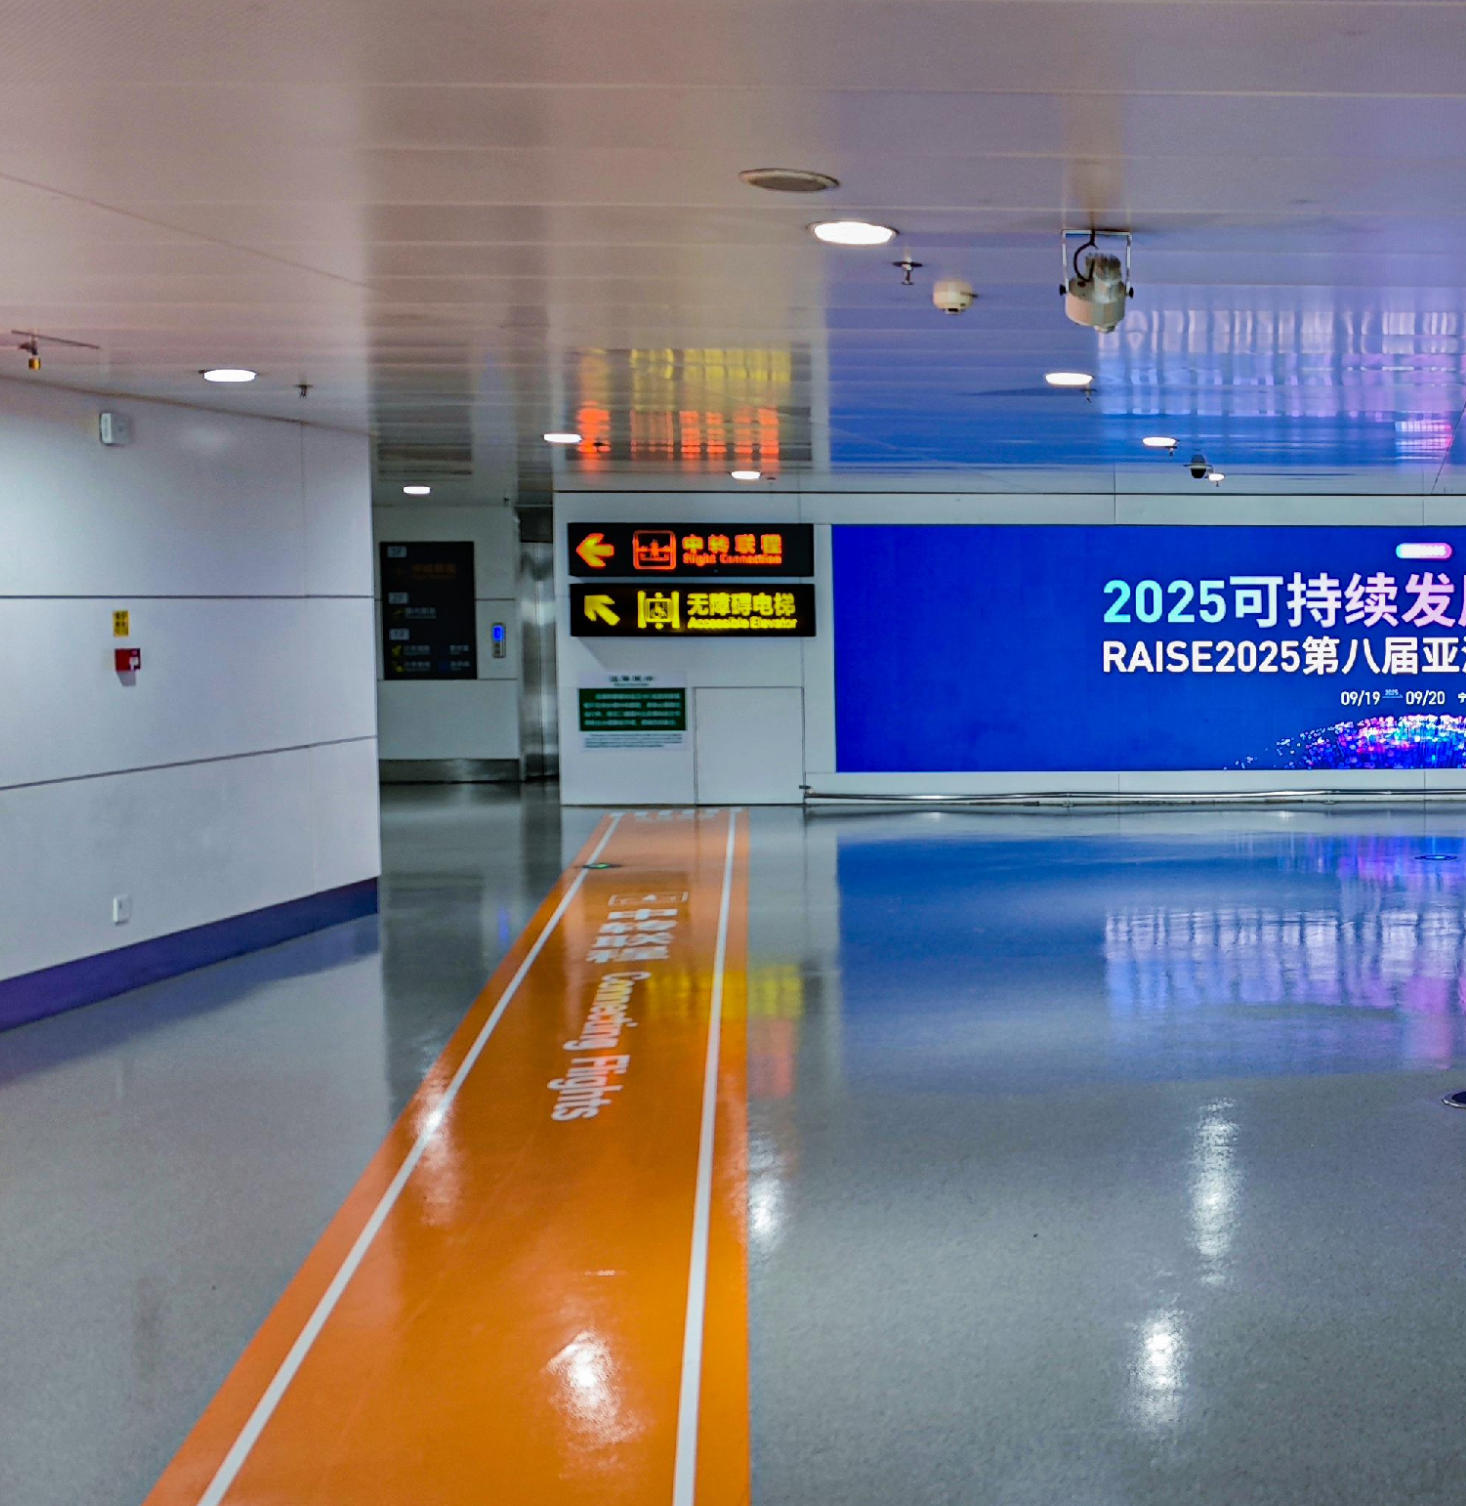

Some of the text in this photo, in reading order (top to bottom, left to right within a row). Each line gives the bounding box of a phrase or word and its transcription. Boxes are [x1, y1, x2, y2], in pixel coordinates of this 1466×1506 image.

[687, 592, 796, 616] 无障碍电梯
[1341, 690, 1381, 707] 09/19
[1406, 690, 1446, 706] 09/20
[547, 971, 652, 1122] Connecting Flights
